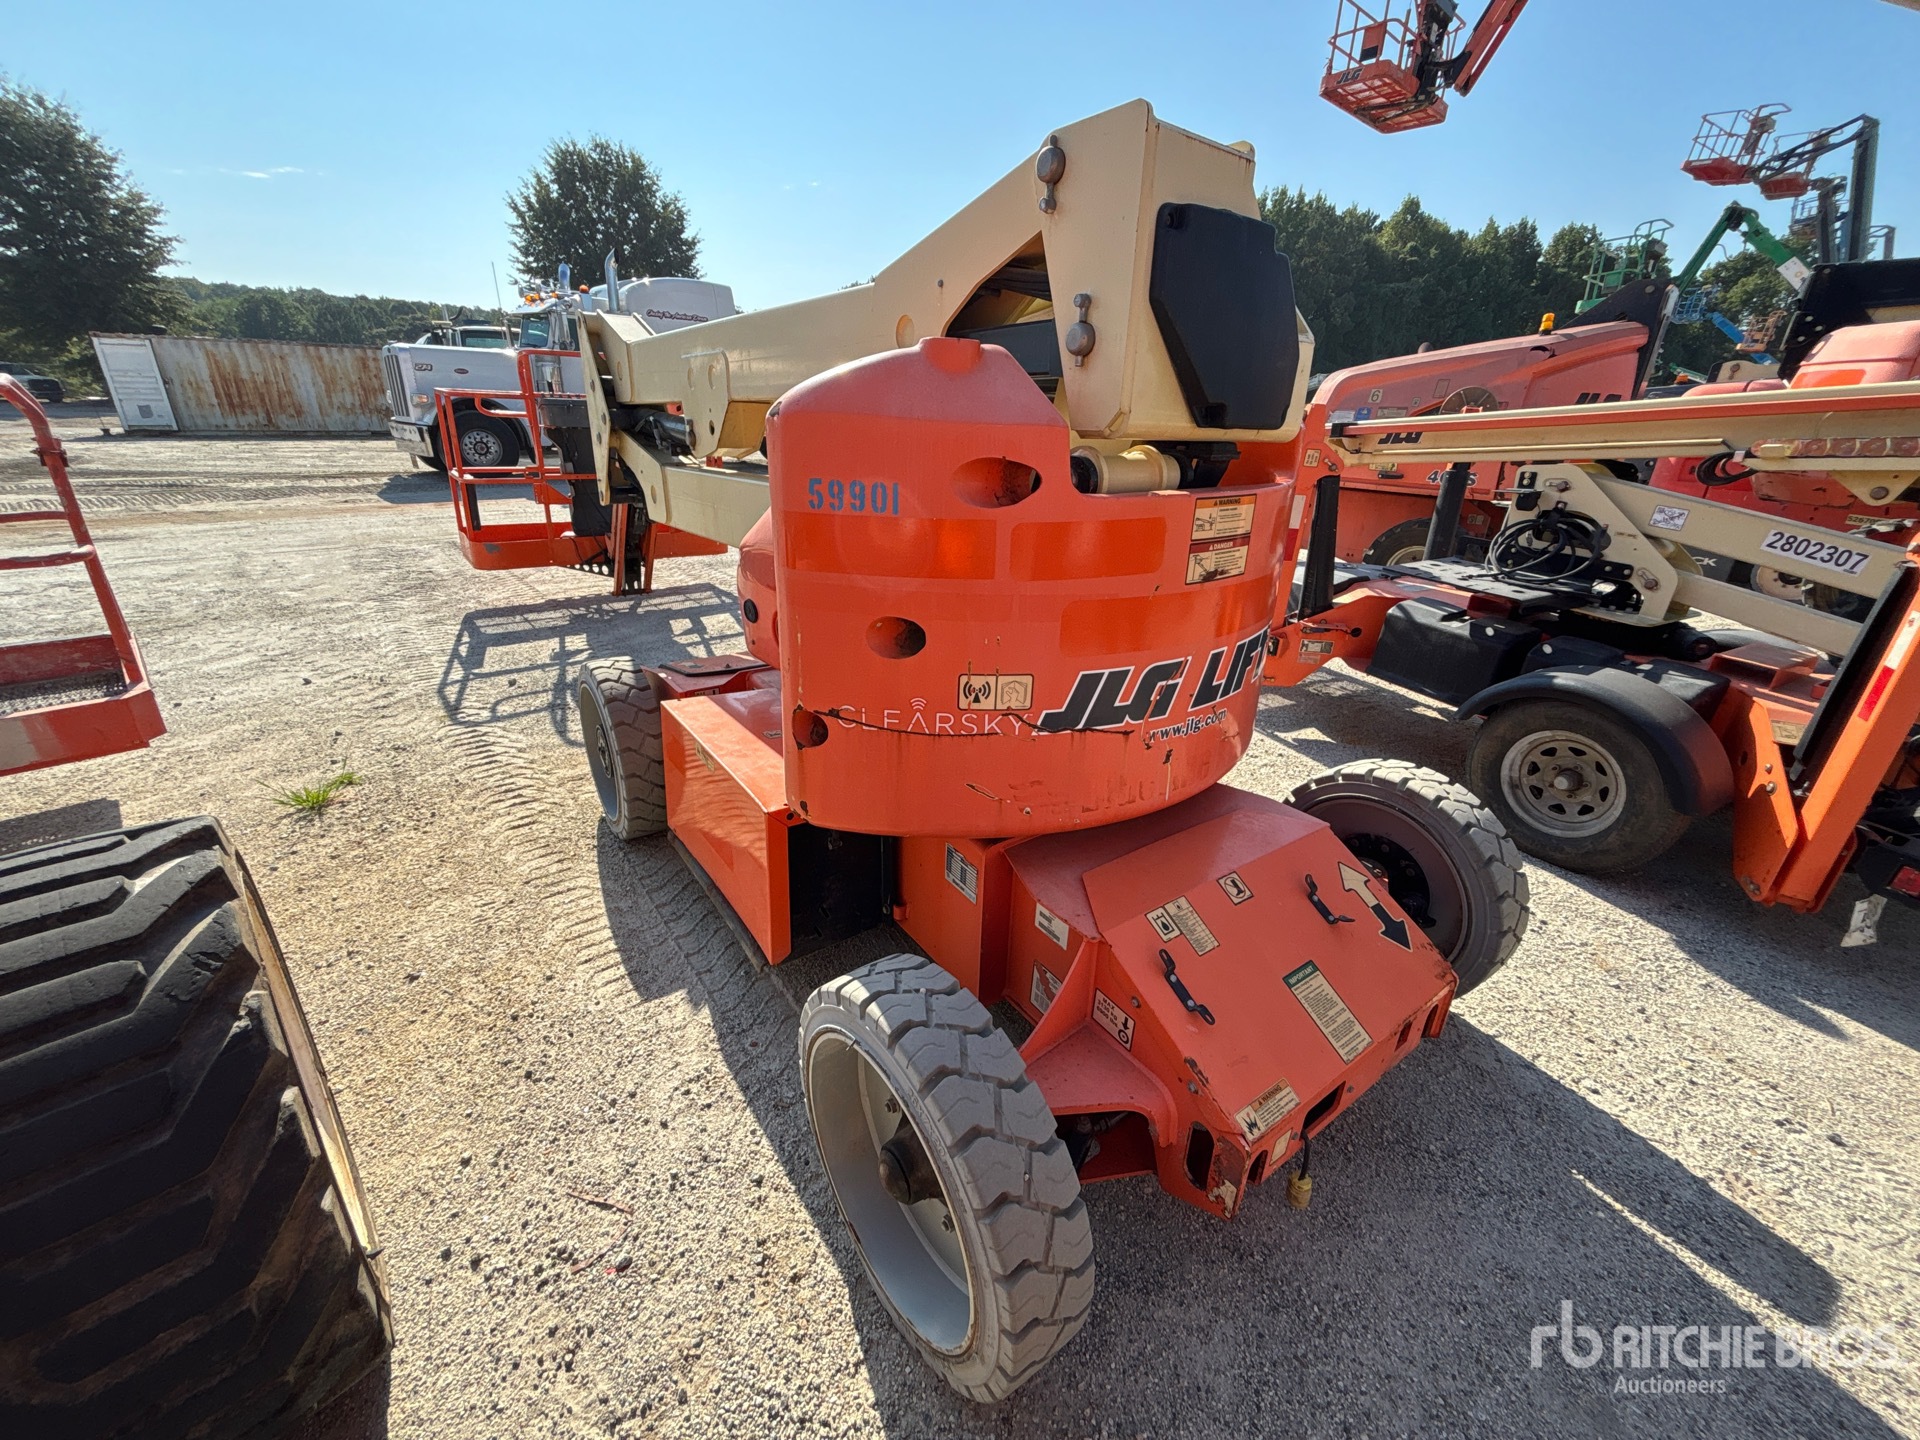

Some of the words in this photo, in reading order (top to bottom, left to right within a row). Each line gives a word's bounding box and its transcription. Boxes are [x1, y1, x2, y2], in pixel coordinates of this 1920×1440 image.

[1335, 67, 1363, 84] JLG
[1371, 389, 1381, 402] 6
[808, 478, 899, 515] 59901
[1219, 498, 1241, 506] WARNING
[1213, 541, 1234, 550] DANGER
[1766, 531, 1869, 571] 2802307
[1033, 656, 1193, 736] JLG
[836, 705, 1031, 736] CLEARSKY
[1147, 708, 1227, 743] www.jlg.com
[1287, 965, 1314, 985] IMPORTANT
[1262, 1084, 1282, 1102] WARNING
